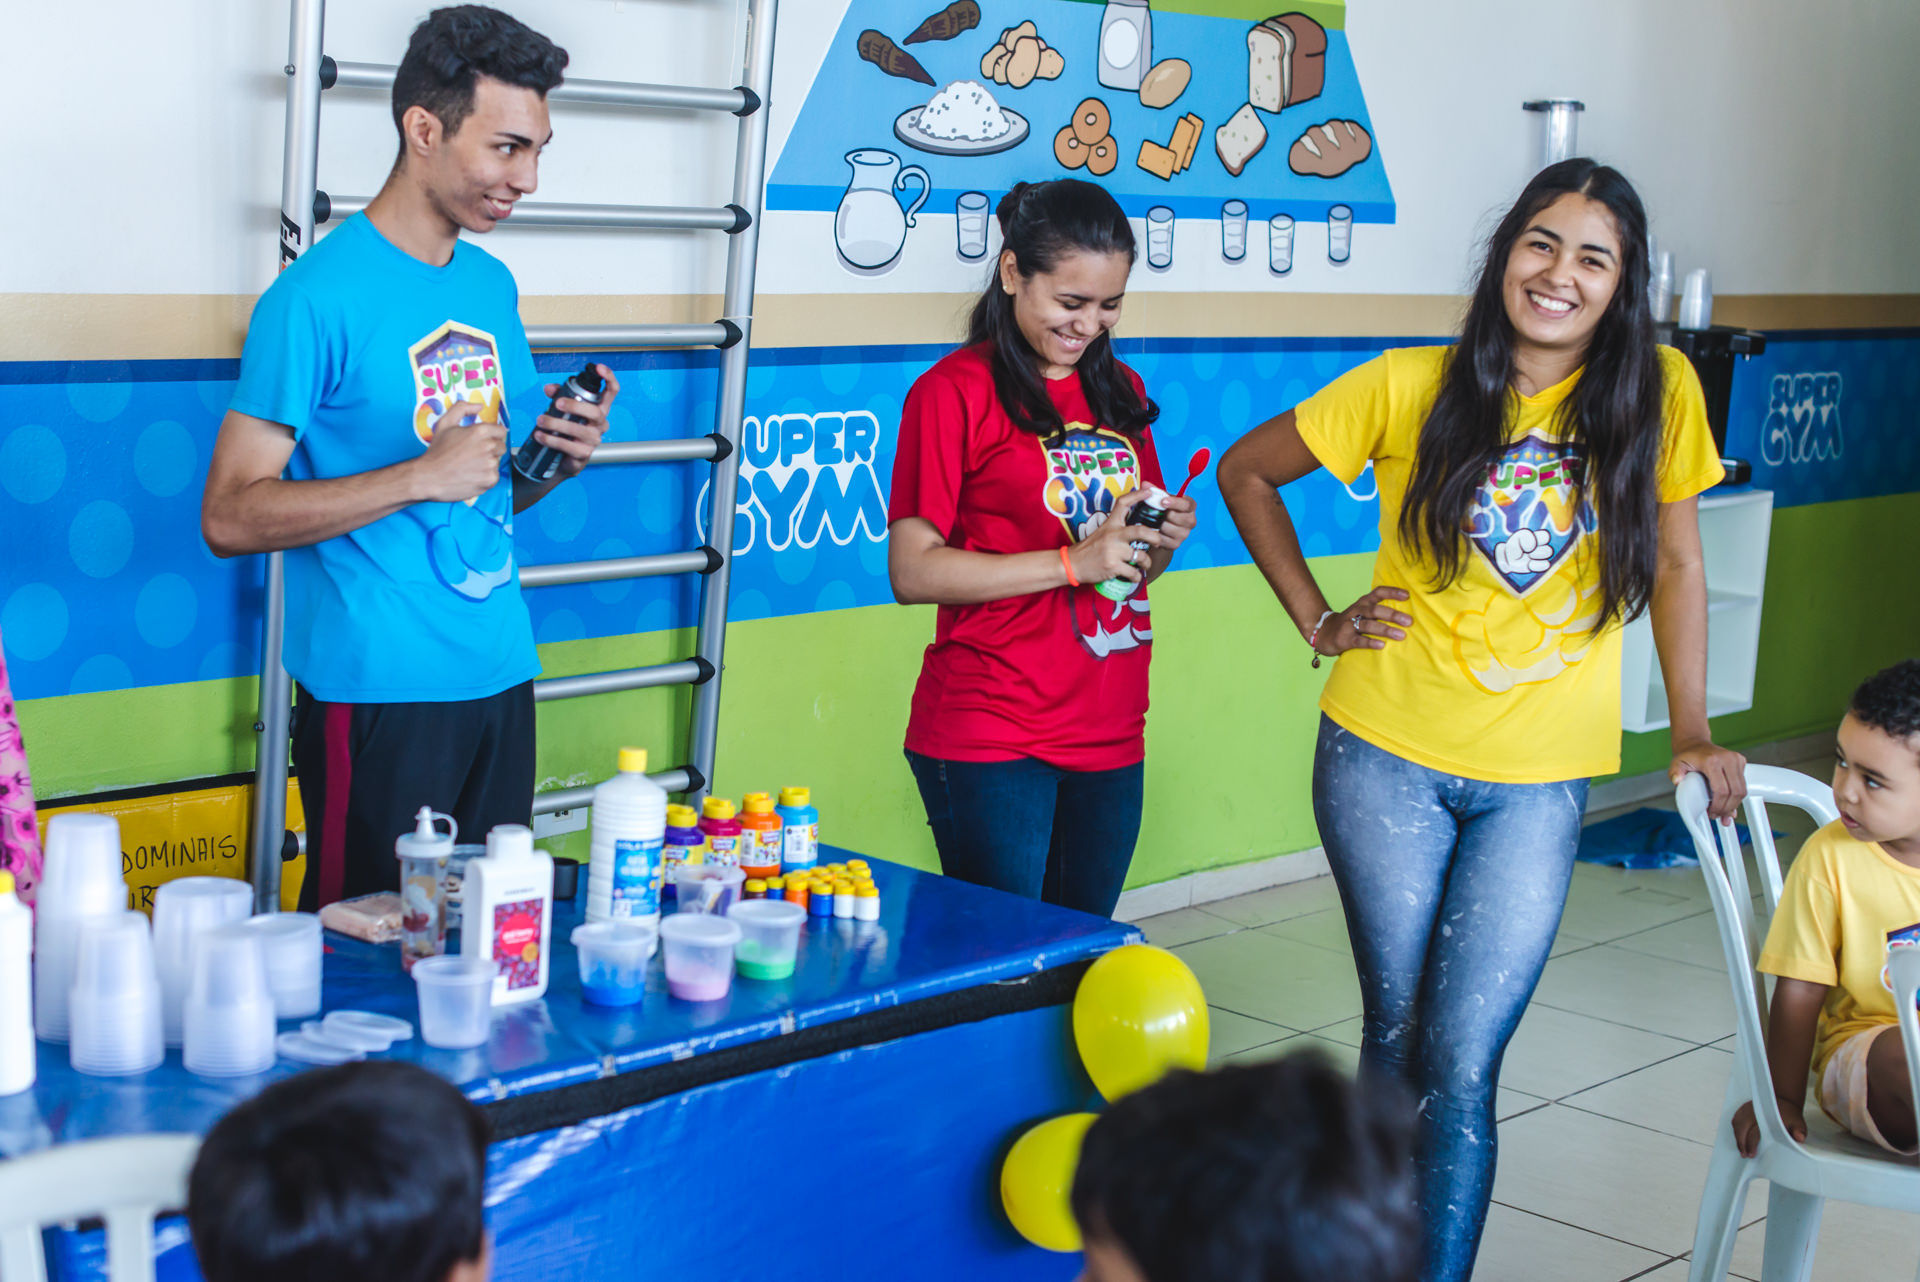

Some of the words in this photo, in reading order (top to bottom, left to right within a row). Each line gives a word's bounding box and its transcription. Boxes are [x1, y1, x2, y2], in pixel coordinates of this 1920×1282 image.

[420, 358, 498, 396] SUPER
[1771, 372, 1842, 409] SUPER
[741, 411, 880, 469] UPER
[1049, 450, 1136, 476] SUPER
[121, 835, 237, 875] DOMINAIS
